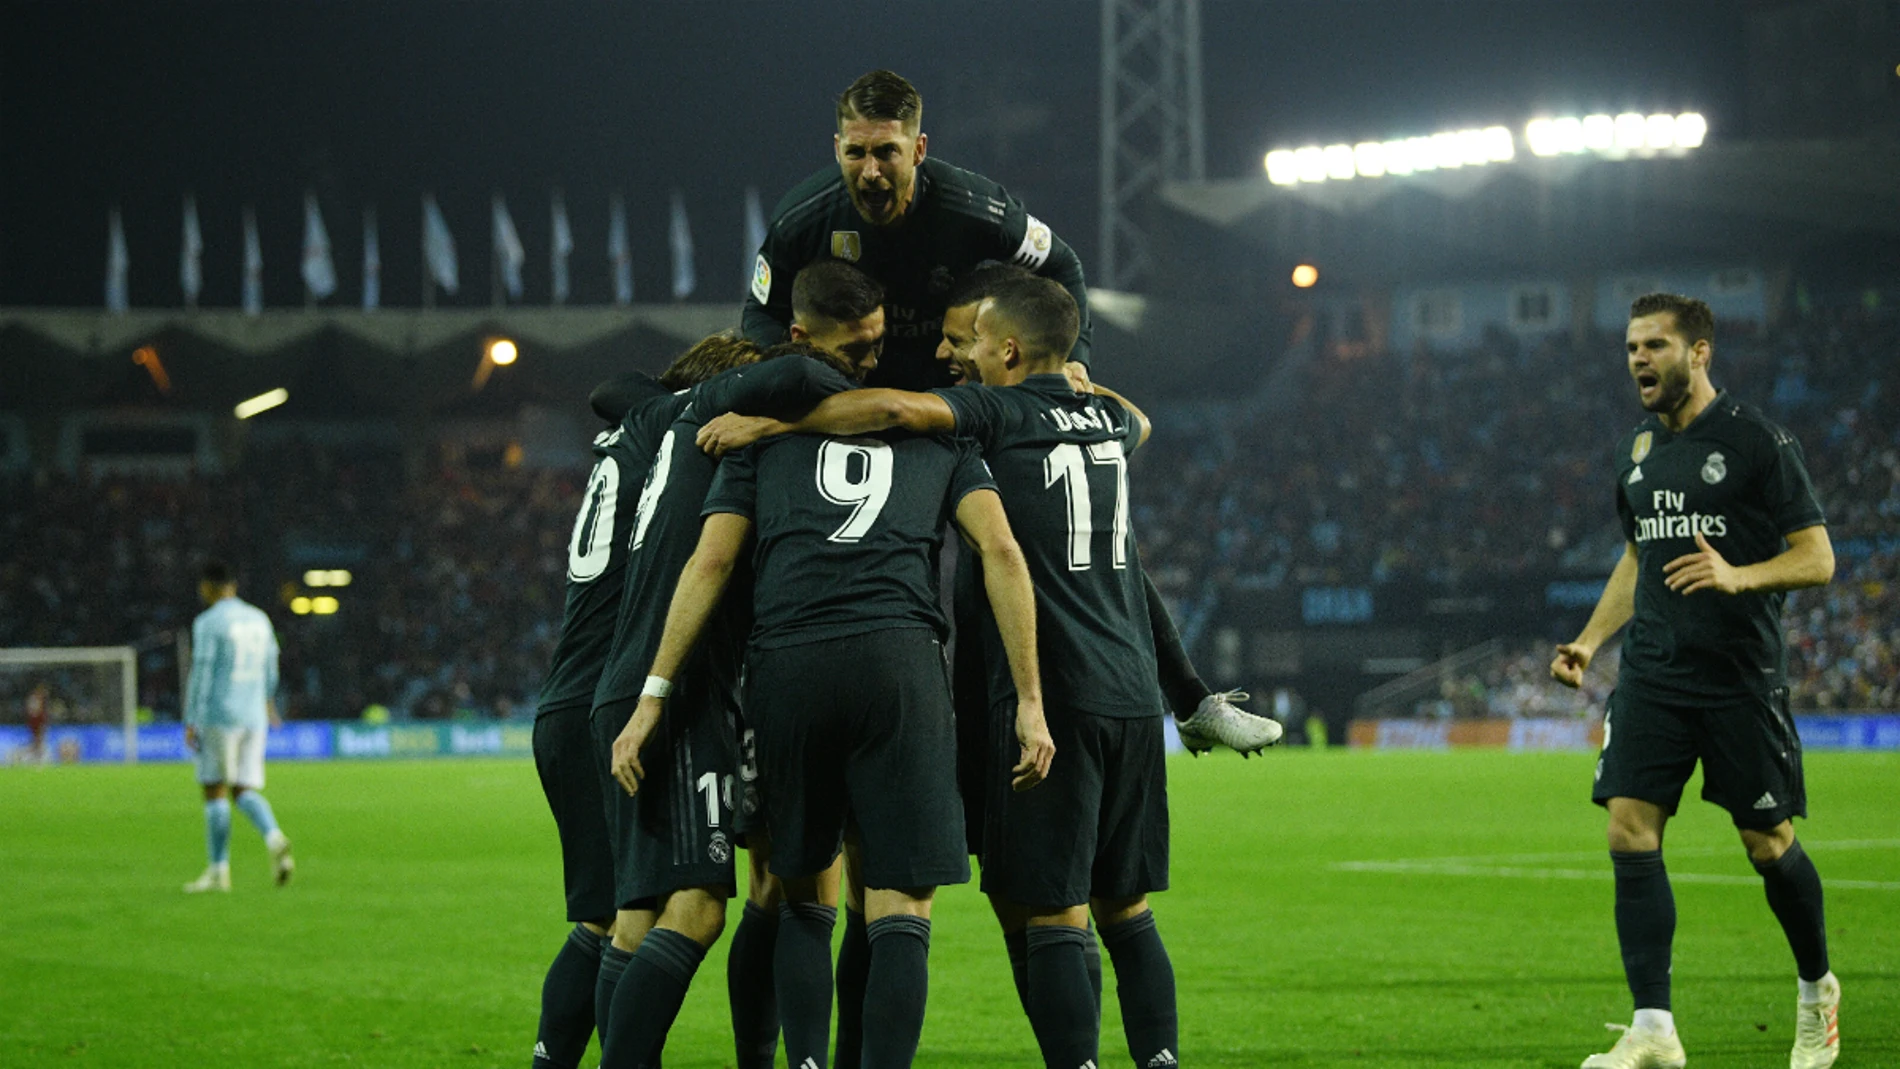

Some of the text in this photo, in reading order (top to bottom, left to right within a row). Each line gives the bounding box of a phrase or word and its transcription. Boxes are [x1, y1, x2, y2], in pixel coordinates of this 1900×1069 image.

[885, 304, 916, 321] ly
[816, 438, 894, 543] 9
[1043, 439, 1128, 571] 17
[1653, 489, 1685, 512] Fly
